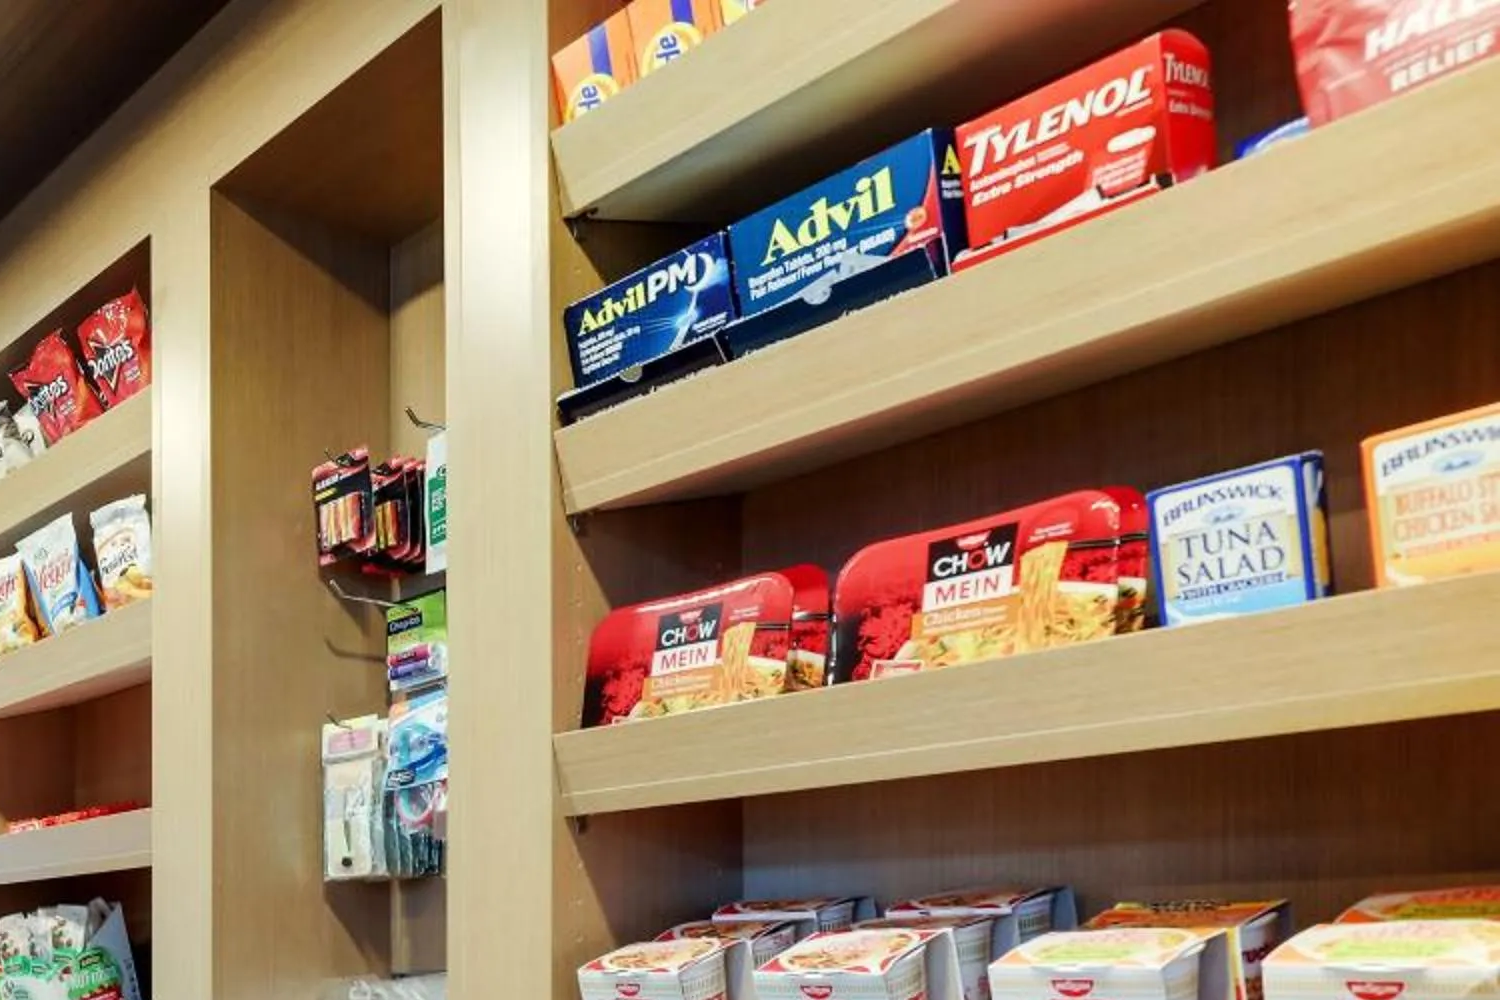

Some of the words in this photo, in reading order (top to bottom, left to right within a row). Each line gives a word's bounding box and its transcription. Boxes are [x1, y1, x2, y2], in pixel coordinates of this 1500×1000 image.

[1390, 28, 1497, 92] RELIEF
[963, 63, 1156, 178] TYLENOL
[760, 165, 896, 266] Advil
[578, 281, 647, 336] Advil
[647, 253, 698, 303] PM
[1163, 478, 1284, 528] BRUNSWICK
[932, 540, 1011, 577] CHOW
[1178, 520, 1279, 560] TUNA
[1177, 545, 1286, 588] SALAD
[934, 574, 1002, 605] MEIN
[661, 618, 717, 647] CHOW
[660, 645, 710, 671] MEIN
